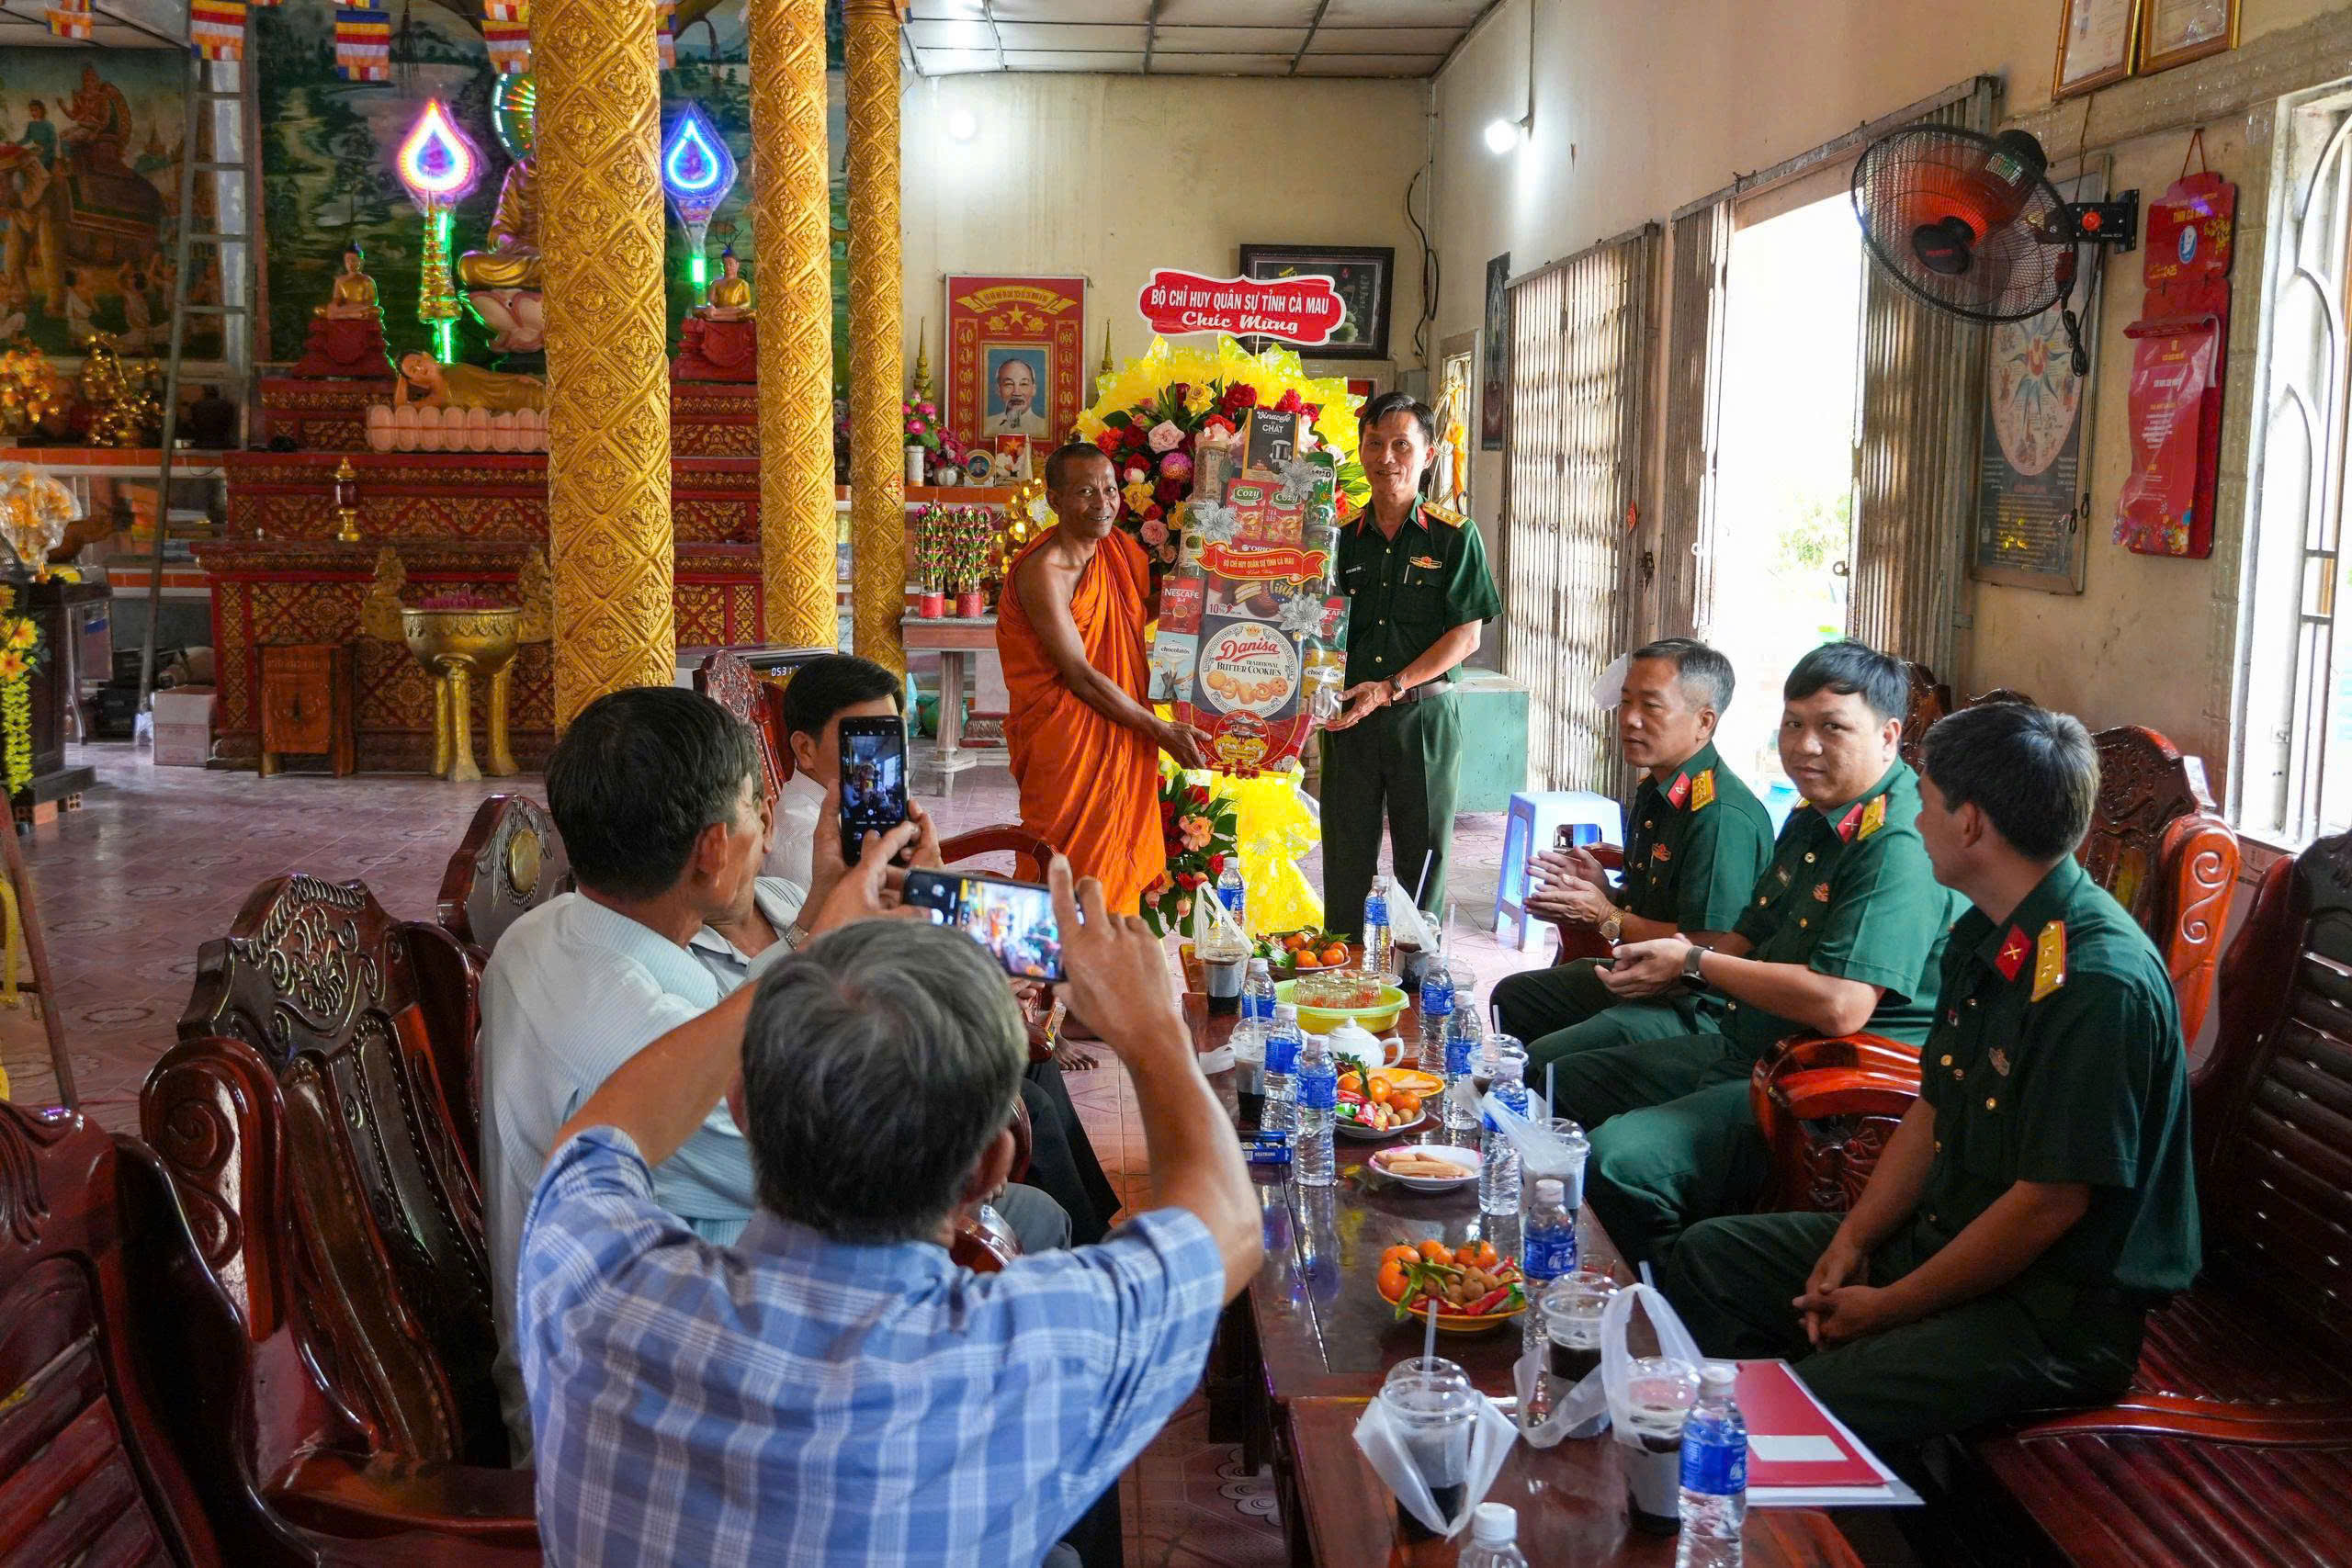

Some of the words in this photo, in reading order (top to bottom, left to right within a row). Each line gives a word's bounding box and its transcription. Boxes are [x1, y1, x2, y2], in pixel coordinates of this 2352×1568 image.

[1151, 288, 1166, 309] BỘ
[1169, 286, 1188, 307] CHỈ
[1189, 291, 1211, 308] HUY
[1214, 289, 1242, 311] QUÂN
[1244, 292, 1260, 313] SỰ
[1262, 288, 1285, 312] TỈNH
[1289, 291, 1302, 313] CÀ
[1306, 297, 1329, 315] MAU
[1182, 310, 1233, 328] Chúc
[1239, 314, 1299, 334] Mừng
[1237, 489, 1260, 498] Cozy
[1216, 637, 1280, 662] Danisa
[1216, 661, 1247, 672] BUTTER
[1249, 665, 1282, 676] COOKIES
